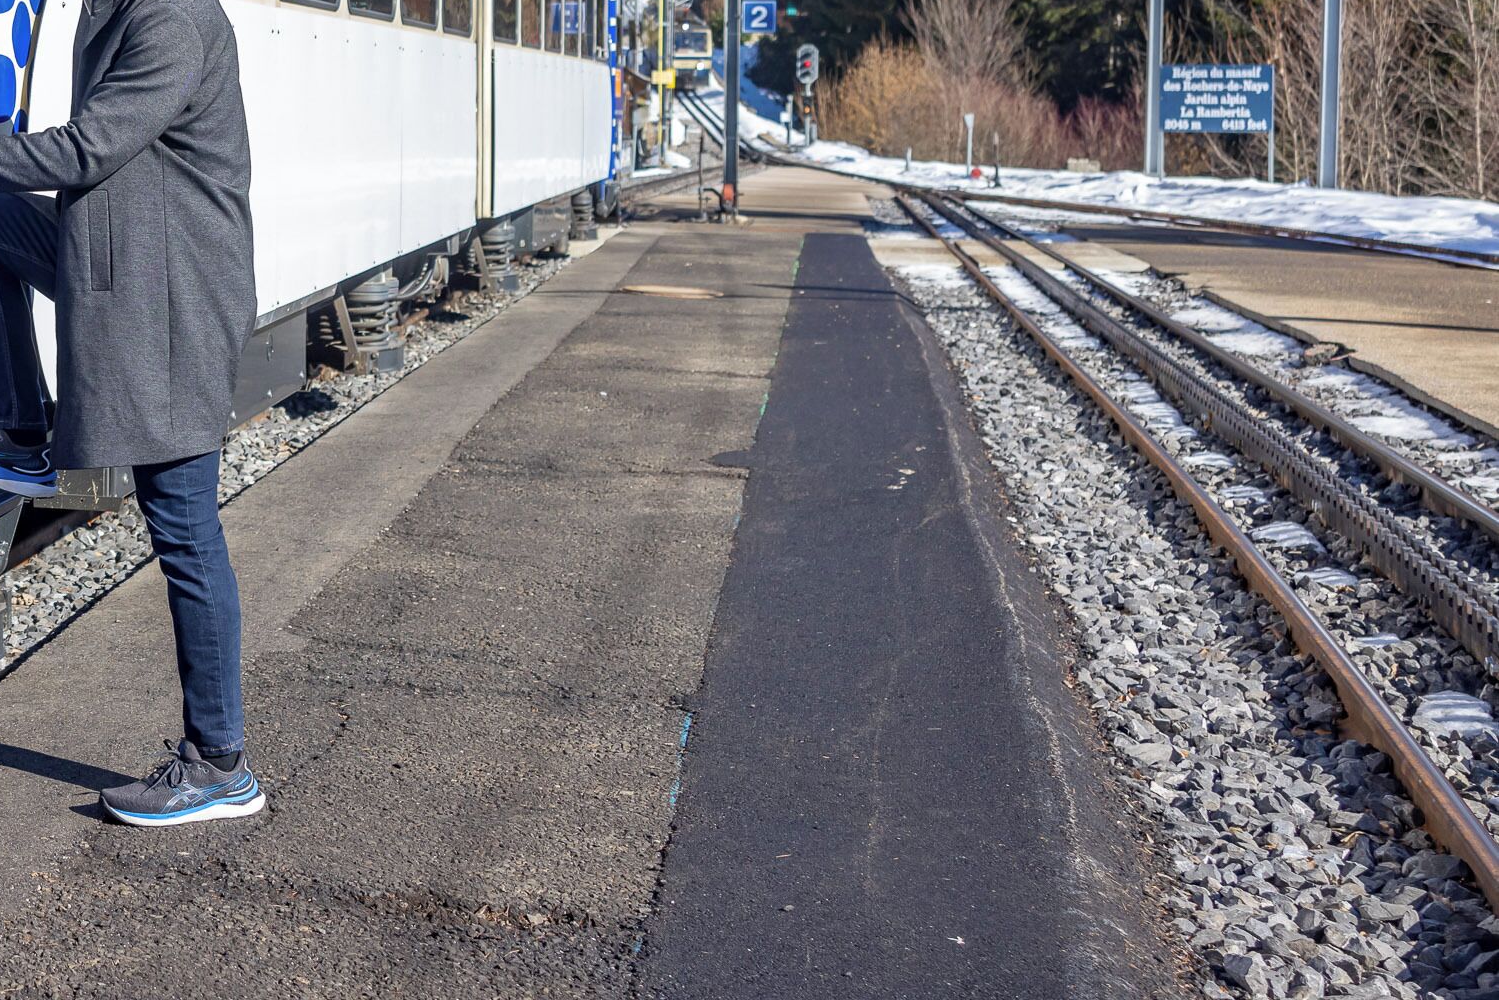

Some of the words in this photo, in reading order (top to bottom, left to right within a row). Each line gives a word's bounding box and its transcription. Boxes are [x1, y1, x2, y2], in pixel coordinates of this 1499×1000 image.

[751, 5, 768, 28] 2
[1172, 66, 1208, 80] Région
[1210, 66, 1224, 79] du
[1225, 66, 1262, 79] massif
[1163, 79, 1181, 92] des
[1183, 79, 1270, 94] Rochers-de-Naye
[1184, 93, 1218, 105] Jardin
[1220, 93, 1247, 107] alpin
[1247, 118, 1267, 131] feet
